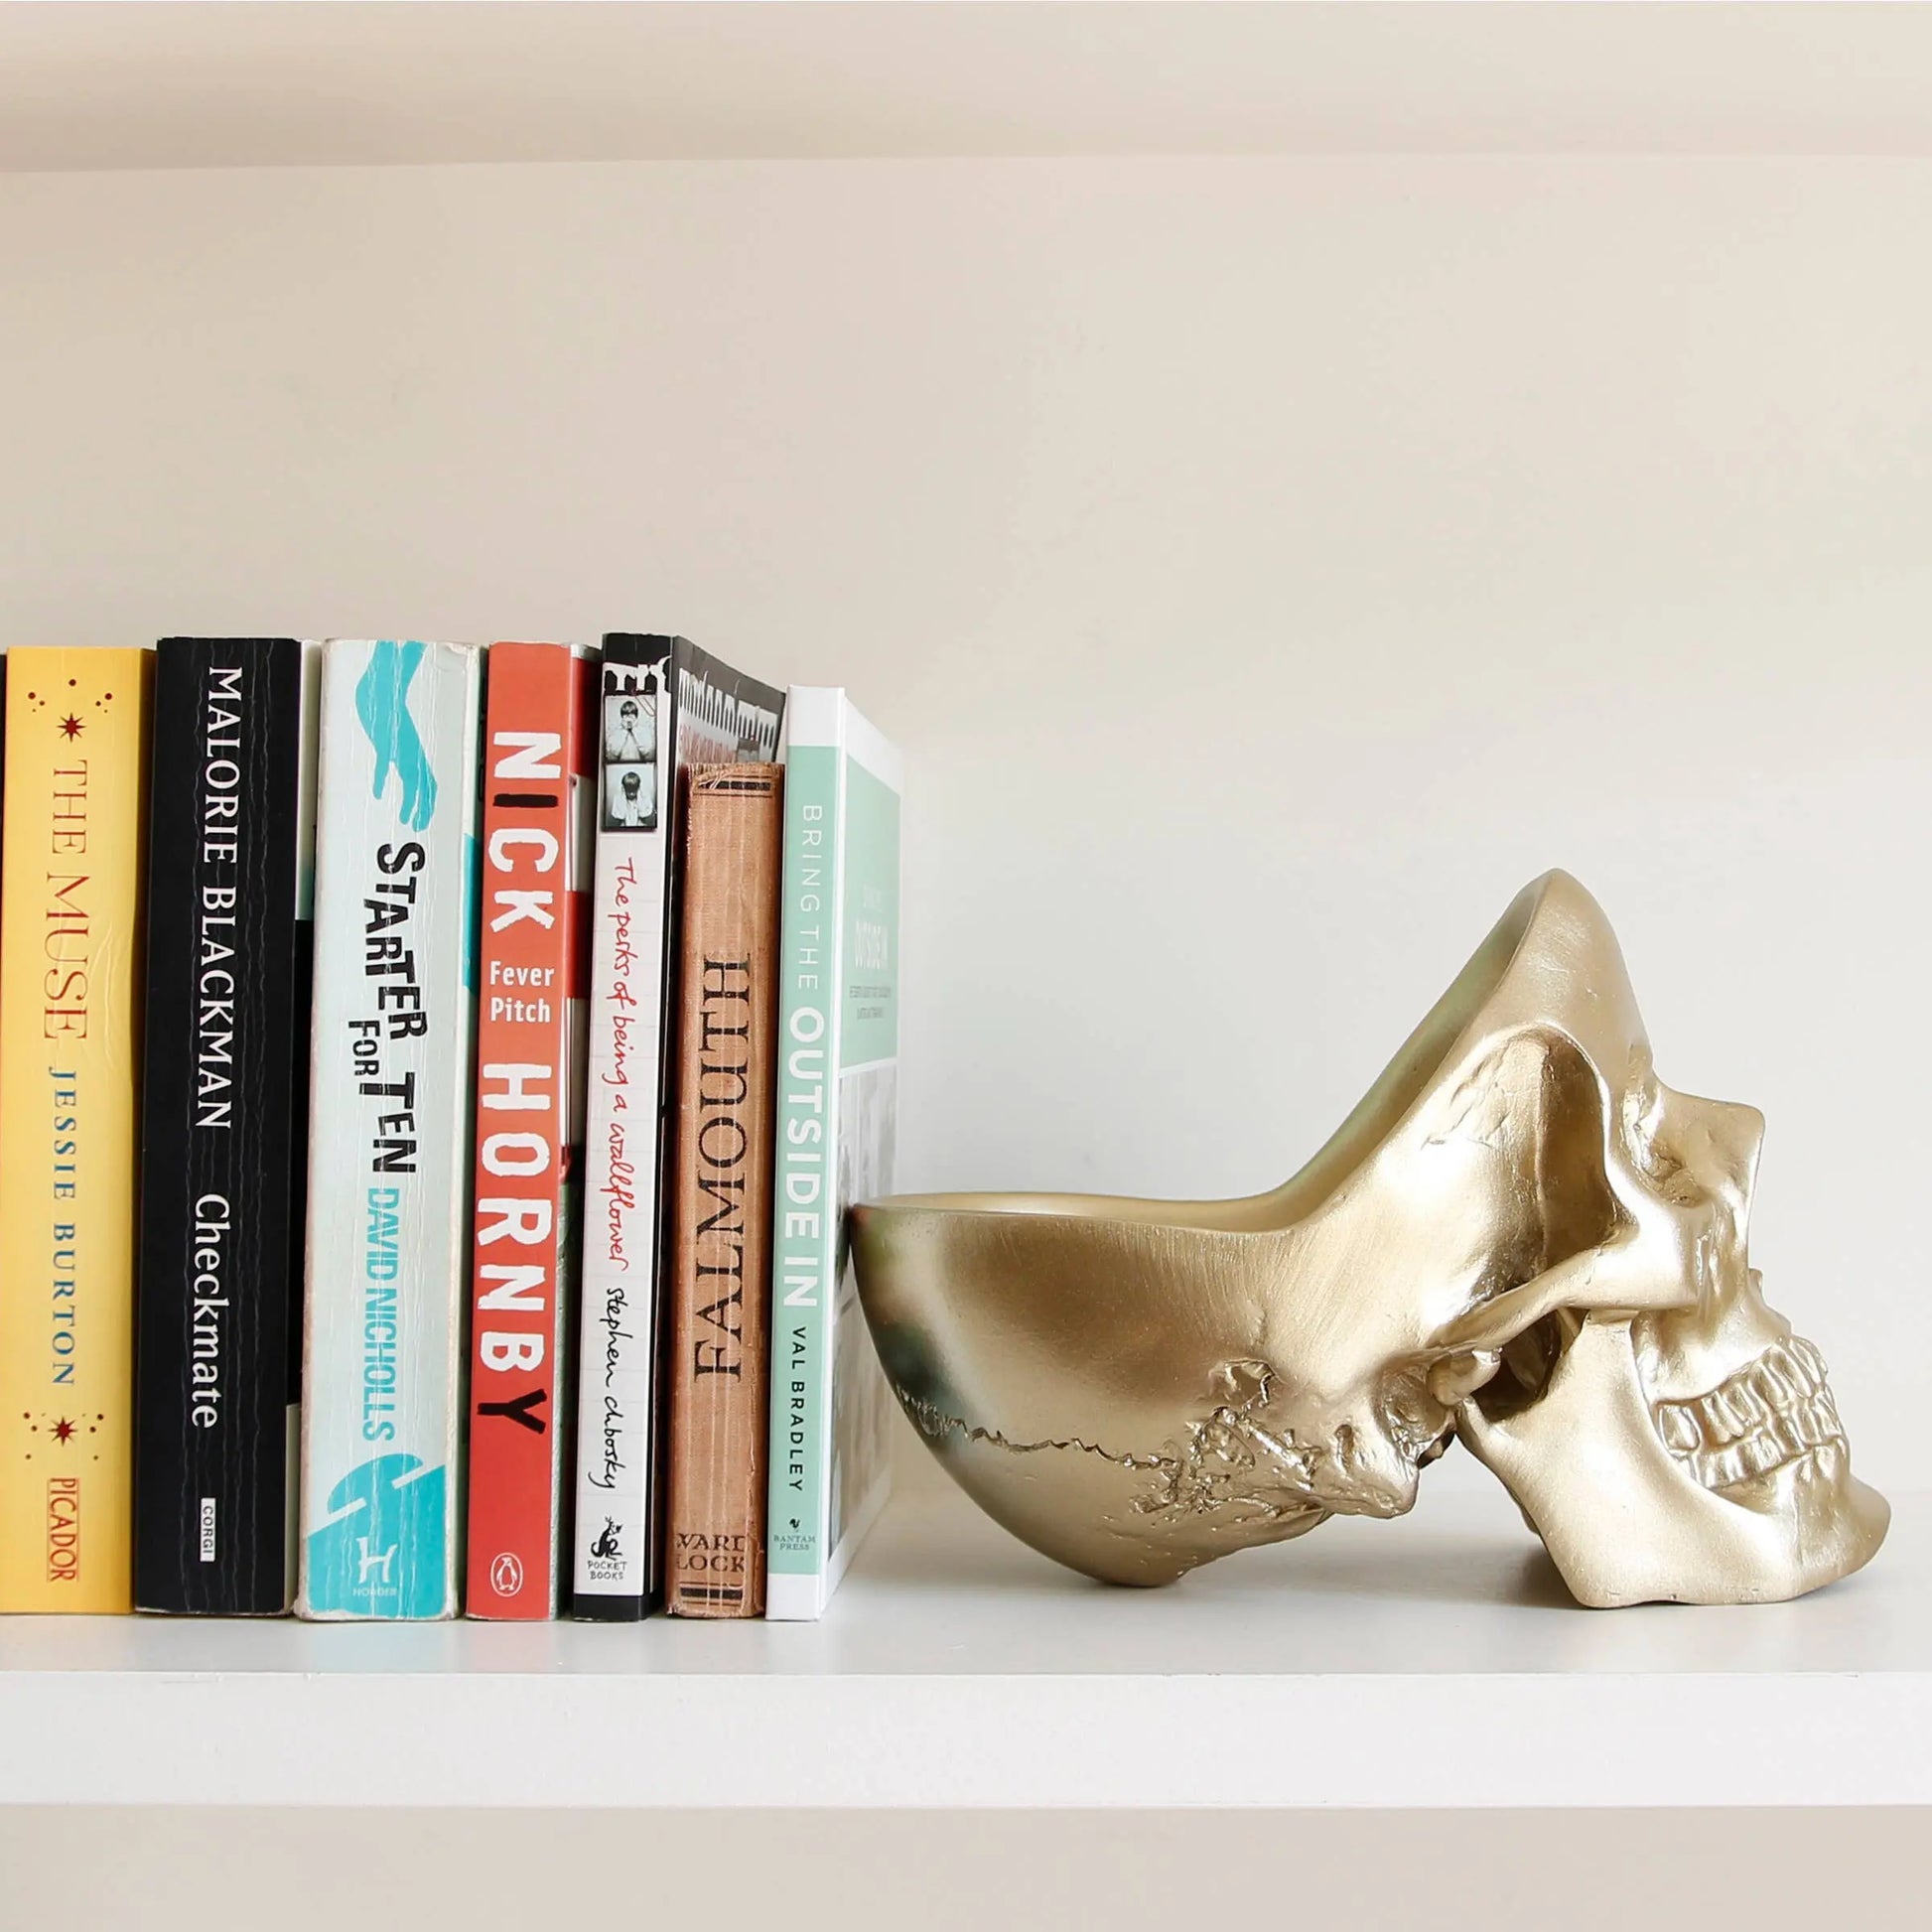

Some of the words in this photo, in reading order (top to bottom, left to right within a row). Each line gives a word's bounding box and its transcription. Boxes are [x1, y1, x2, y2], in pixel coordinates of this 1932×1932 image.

[52, 759, 87, 854] THE
[203, 667, 243, 864] MALORIE
[487, 732, 561, 932] NICK
[800, 805, 823, 912] BRING
[615, 857, 637, 907] The
[44, 873, 90, 1039] MUSE
[364, 842, 428, 1040] STARTER
[489, 960, 555, 987] Fever
[607, 911, 638, 977] perks
[798, 924, 820, 990] THE
[195, 886, 237, 1129] BLACKMAN
[490, 997, 551, 1023] Pitch
[607, 981, 637, 1012] of
[347, 1020, 381, 1076] FOR
[601, 1015, 635, 1086] being
[49, 1066, 76, 1200] JESSIE
[358, 1071, 417, 1173] TEN
[613, 1094, 627, 1113] a
[785, 1007, 825, 1240] OUTSIDE
[599, 1123, 635, 1272] wallflower
[695, 953, 751, 1383] FALMOUTH
[366, 1187, 400, 1280] DAVID
[477, 1063, 553, 1435] HORNBY
[53, 1223, 75, 1386] BURTON
[192, 1193, 230, 1429] Checkmate
[783, 1256, 819, 1307] IN
[362, 1288, 397, 1442] NICHOLLS
[791, 1326, 806, 1370] VAL
[788, 1381, 805, 1491] BRADLEY
[50, 1477, 77, 1582] PICADOR
[203, 1505, 213, 1554] CORGI
[588, 1560, 627, 1571] POCKET
[590, 1571, 624, 1581] BOOKS
[676, 1554, 745, 1573] LOCK
[773, 1534, 815, 1543] BANTAM
